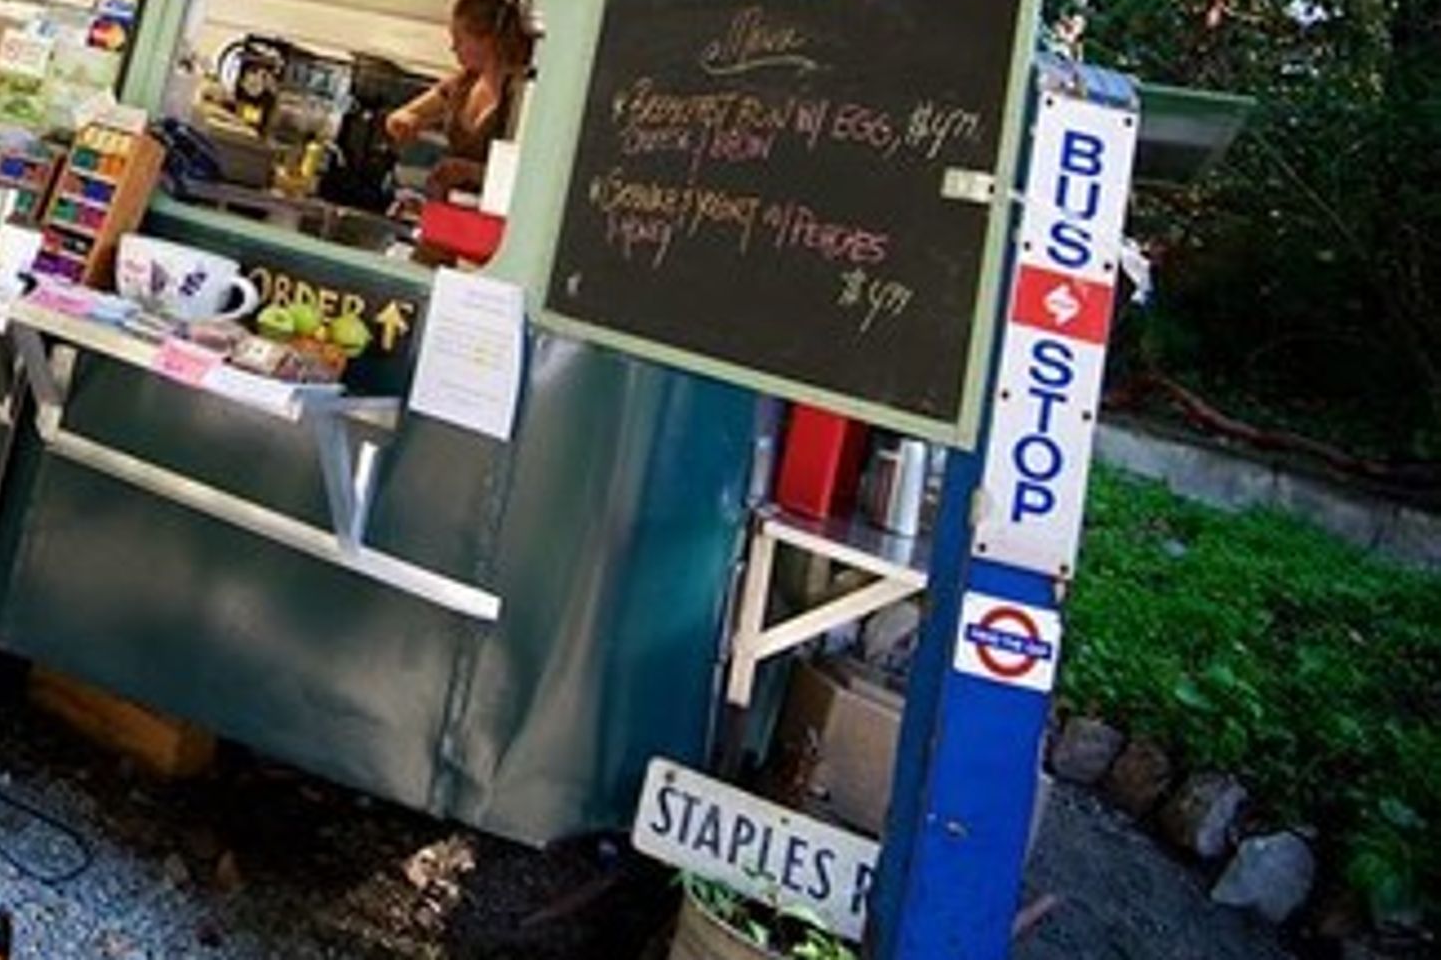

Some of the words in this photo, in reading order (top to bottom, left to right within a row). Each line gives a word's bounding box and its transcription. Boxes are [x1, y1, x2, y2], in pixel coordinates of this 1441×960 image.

[1046, 130, 1104, 269] BUS
[1011, 340, 1075, 523] STOP
[651, 786, 836, 900] STAPLES
